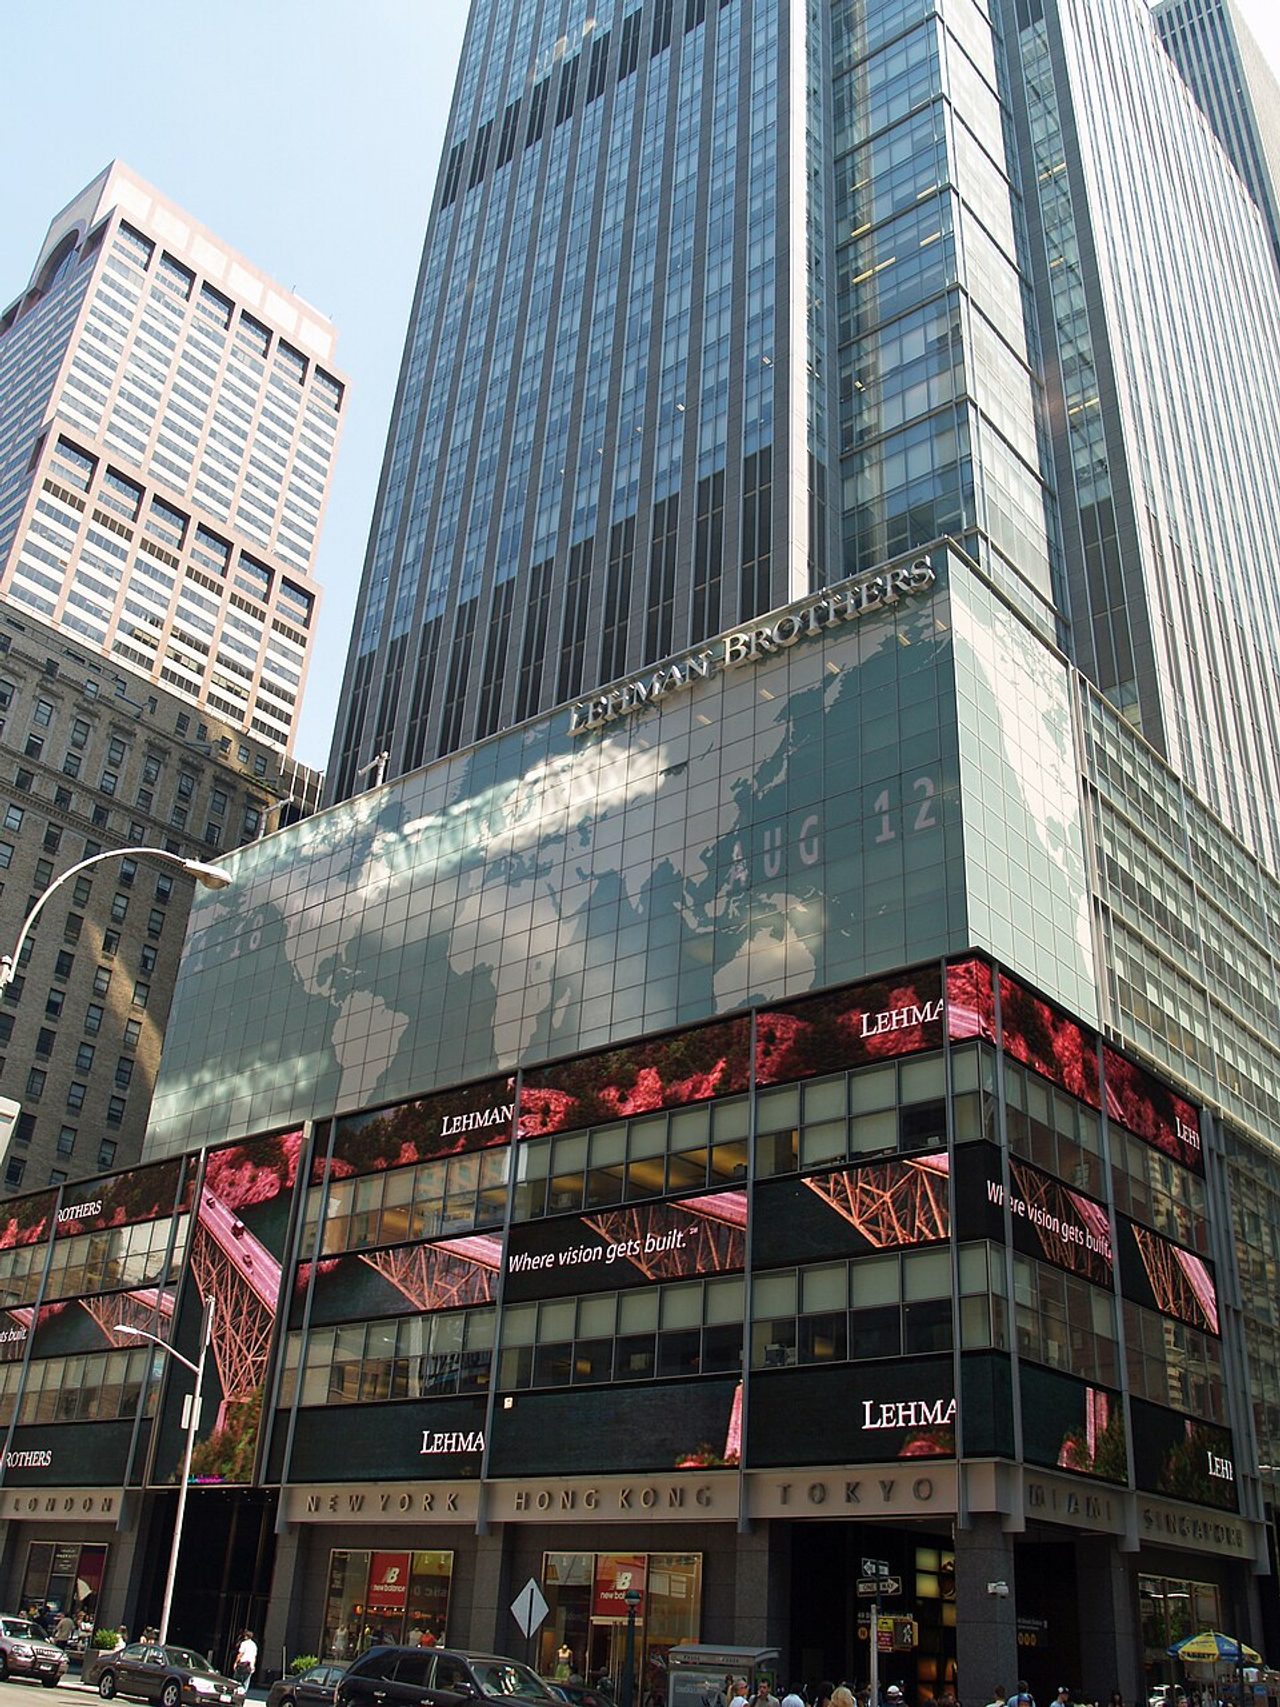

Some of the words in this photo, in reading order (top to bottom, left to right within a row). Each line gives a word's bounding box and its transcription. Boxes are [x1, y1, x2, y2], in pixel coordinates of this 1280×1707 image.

[567, 649, 715, 737] LEHMAN
[721, 554, 937, 670] BROTHERS
[728, 813, 821, 890] AUG
[872, 776, 938, 844] 12
[440, 1103, 515, 1137] LEHMAN
[1027, 1202, 1060, 1234] vision
[1061, 1222, 1085, 1246] gets
[508, 1252, 555, 1274] Where
[558, 1244, 603, 1267] vision
[605, 1239, 641, 1265] gets
[643, 1229, 687, 1255] built.
[12, 1496, 114, 1513] LONDON
[305, 1495, 365, 1513] NEW
[378, 1492, 460, 1512] YORK
[513, 1489, 600, 1511] HONG
[618, 1485, 713, 1509] KONG
[776, 1477, 934, 1506] TOKYO
[1028, 1483, 1112, 1522] MIAMI
[1142, 1507, 1245, 1550] SINGAPORE
[600, 1591, 614, 1600] new
